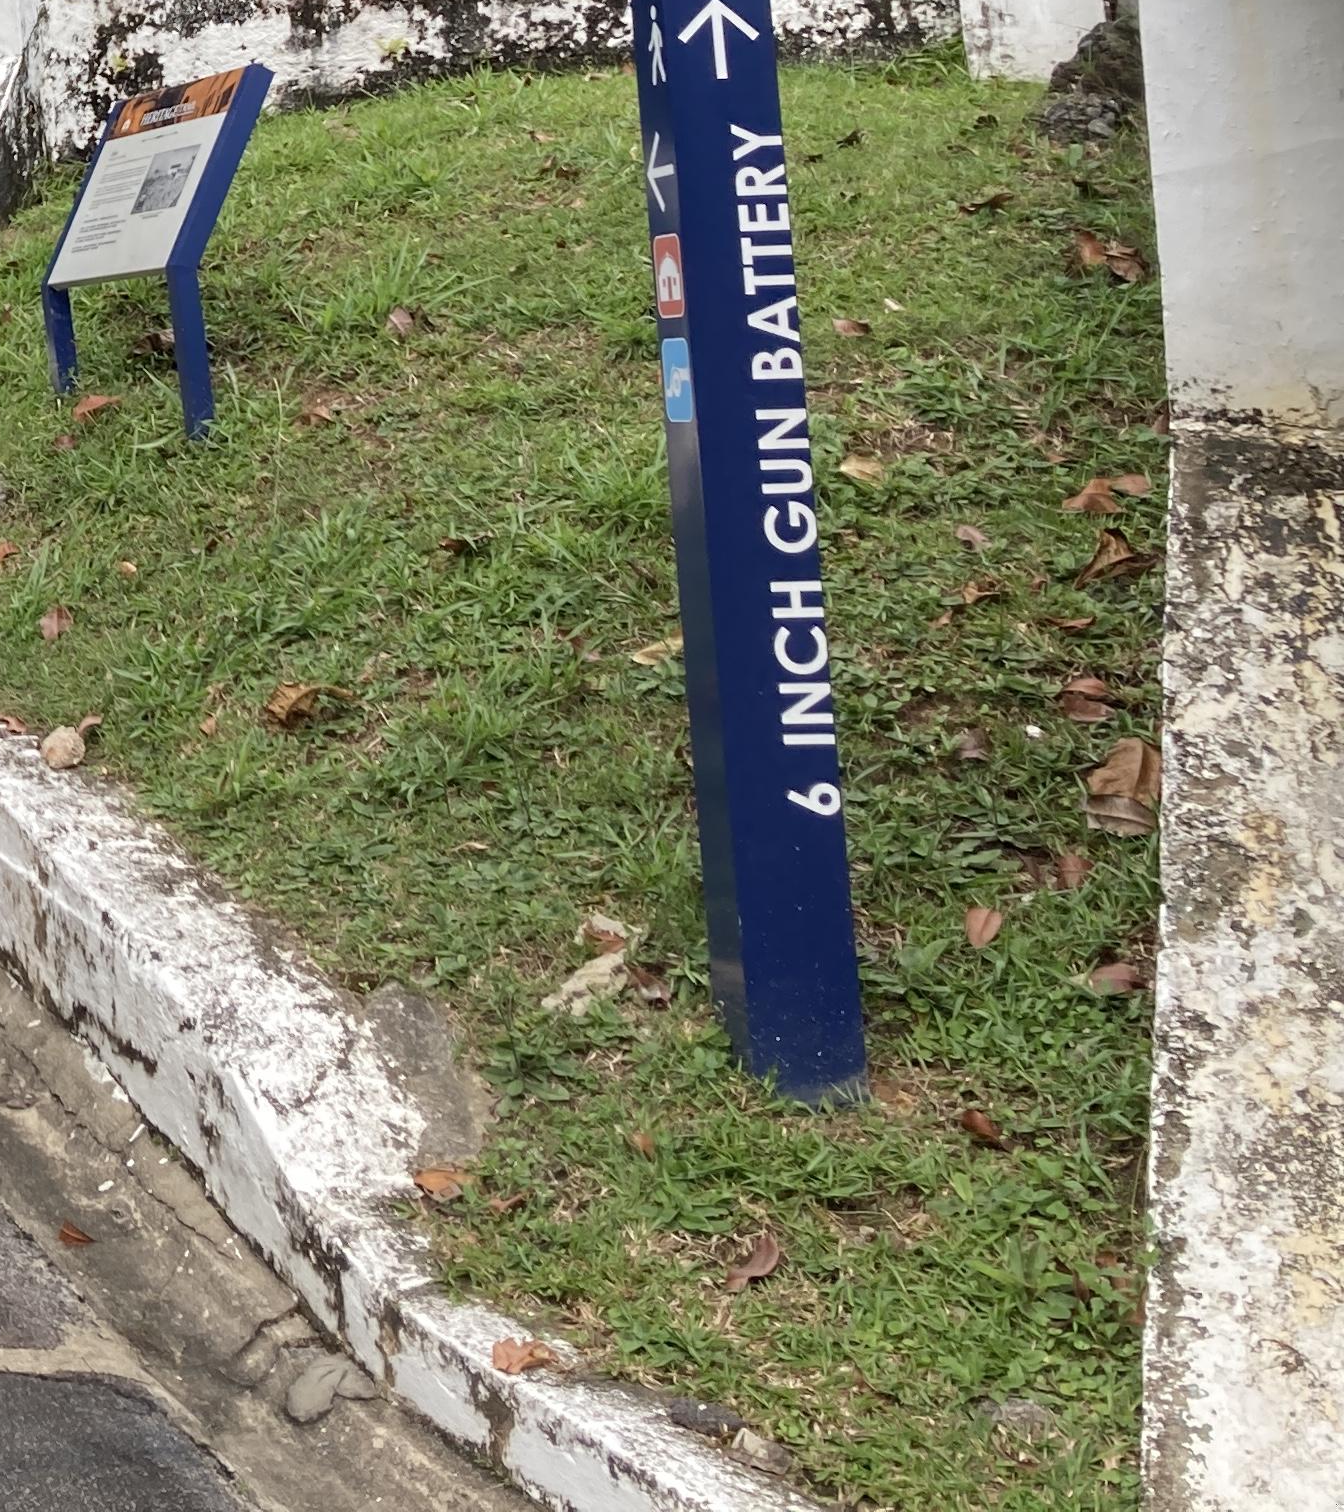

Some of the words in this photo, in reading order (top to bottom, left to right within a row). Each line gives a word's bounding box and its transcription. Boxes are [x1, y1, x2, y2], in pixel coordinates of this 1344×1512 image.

[729, 122, 805, 381] BATTERY
[754, 407, 818, 555] GUN
[769, 580, 837, 746] INCH
[786, 782, 842, 817] 6
